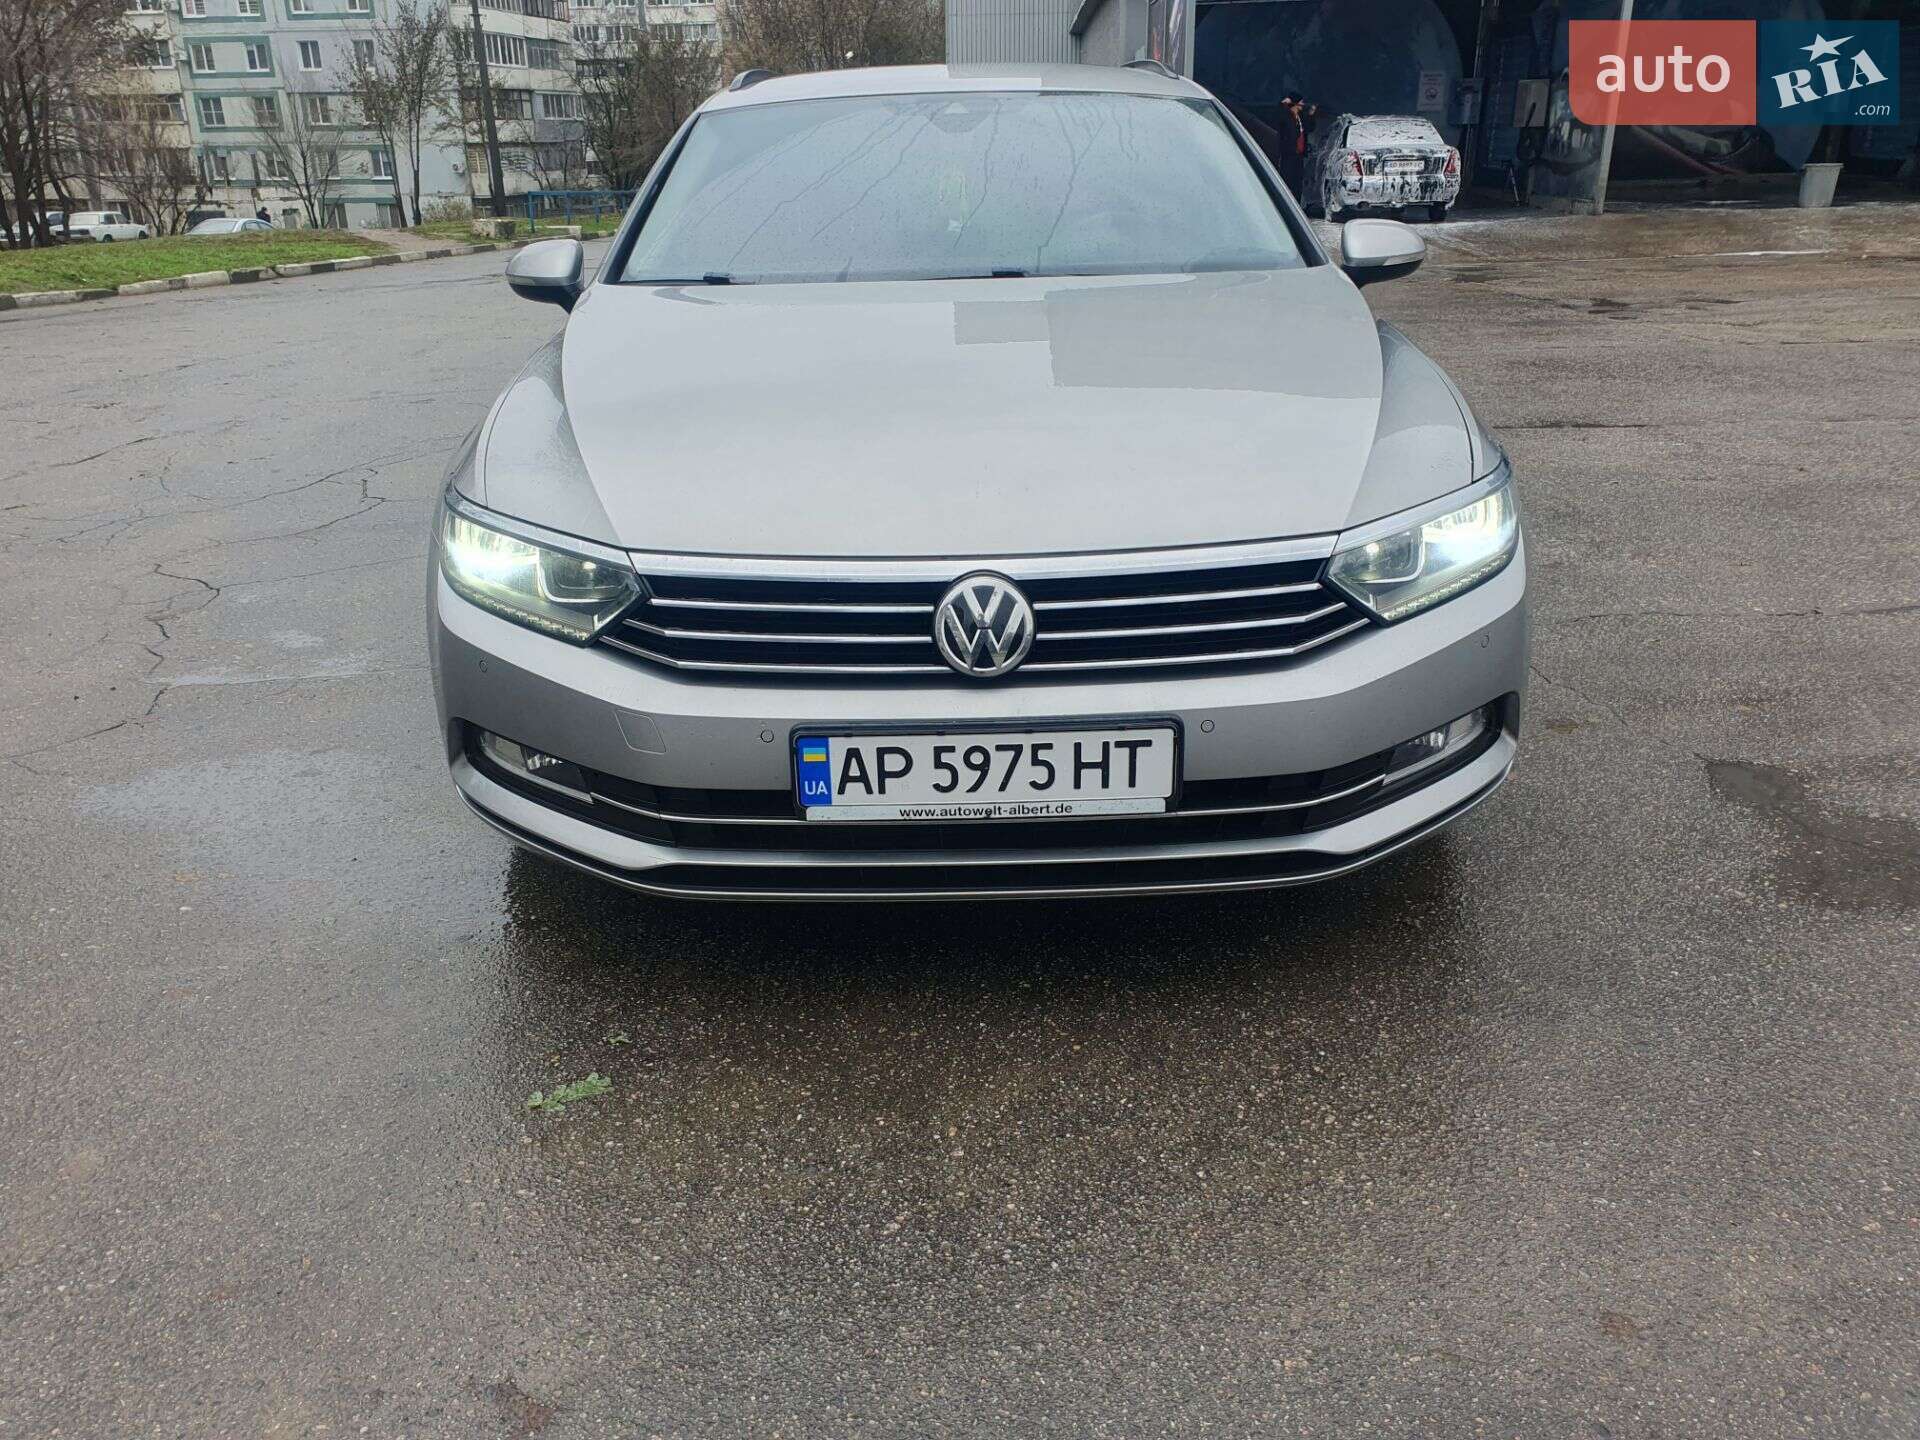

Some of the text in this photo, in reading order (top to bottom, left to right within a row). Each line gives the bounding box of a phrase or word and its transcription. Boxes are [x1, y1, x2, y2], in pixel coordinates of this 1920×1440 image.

[837, 739, 1153, 795] AP 5975 HT
[804, 780, 828, 795] UA
[899, 803, 1073, 818] www.autowelt-albert.de
